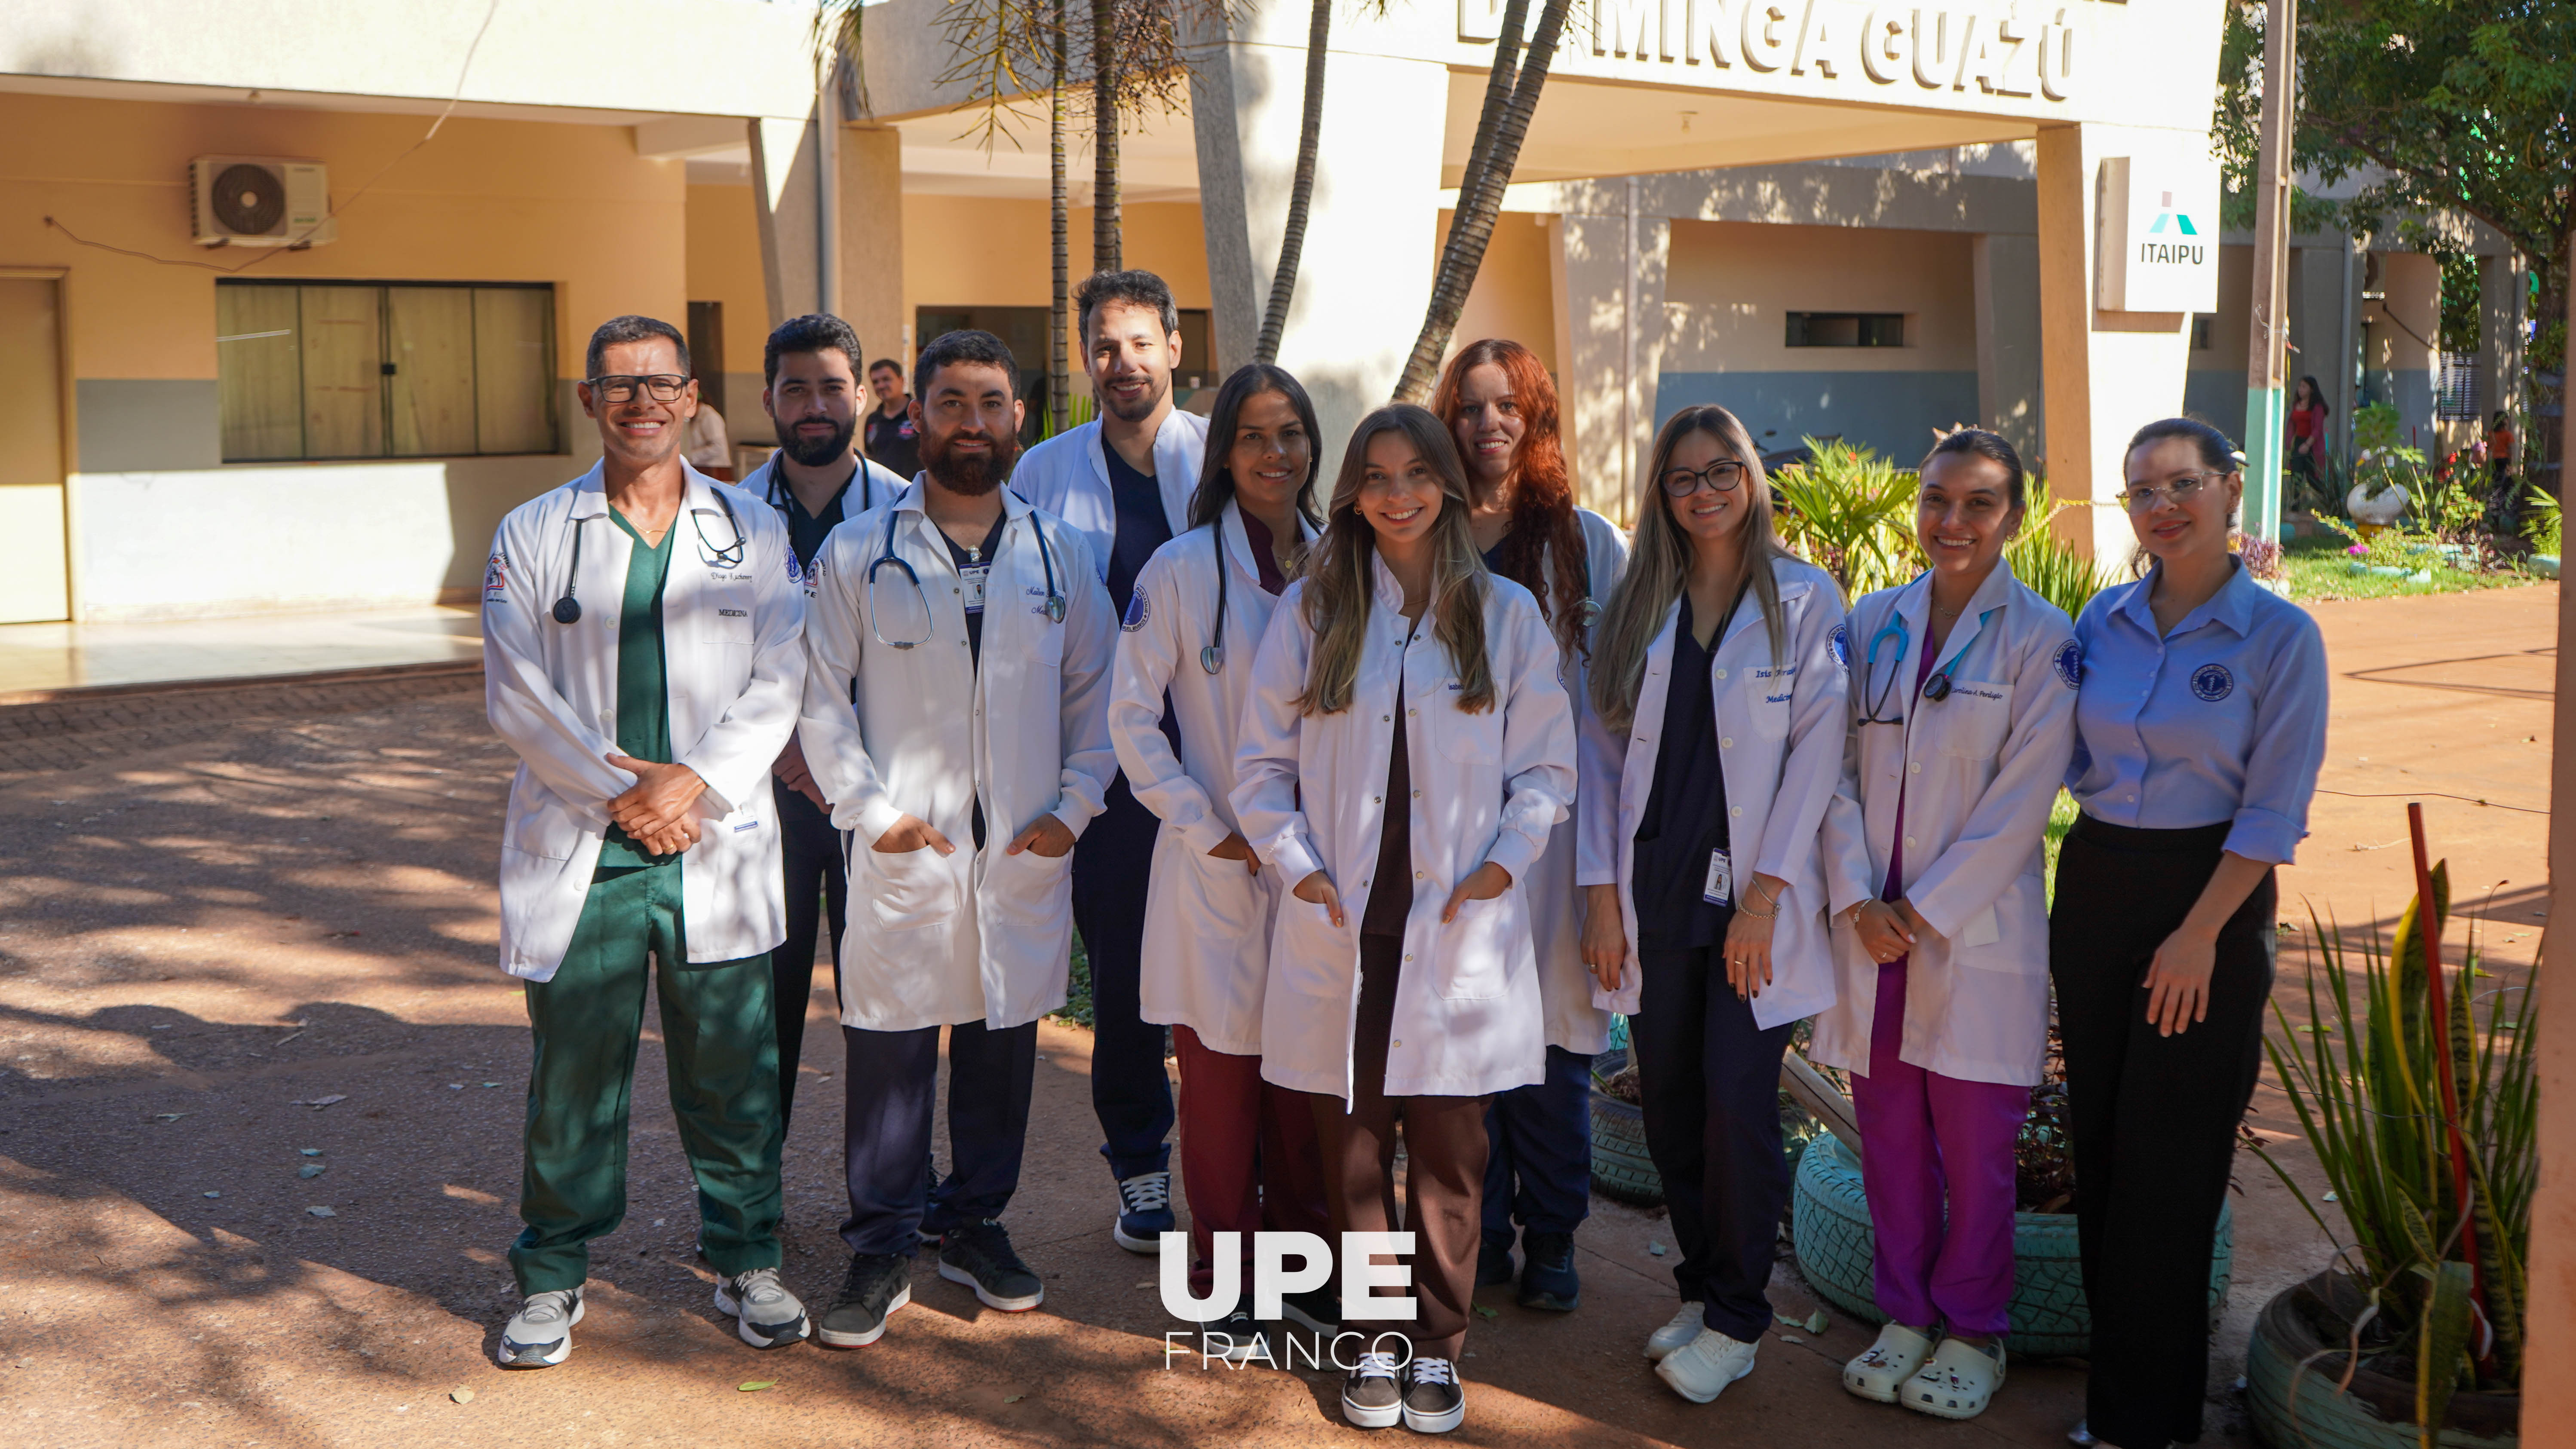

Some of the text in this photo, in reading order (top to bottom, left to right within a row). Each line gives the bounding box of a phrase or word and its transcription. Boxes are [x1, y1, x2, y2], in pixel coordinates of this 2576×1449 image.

[1861, 6, 2072, 102] GUAZÚ
[2141, 243, 2203, 264] ITAIPU
[718, 609, 748, 617] MEDICINA
[1755, 669, 1772, 678] Isis
[1951, 687, 1972, 695] Carolina
